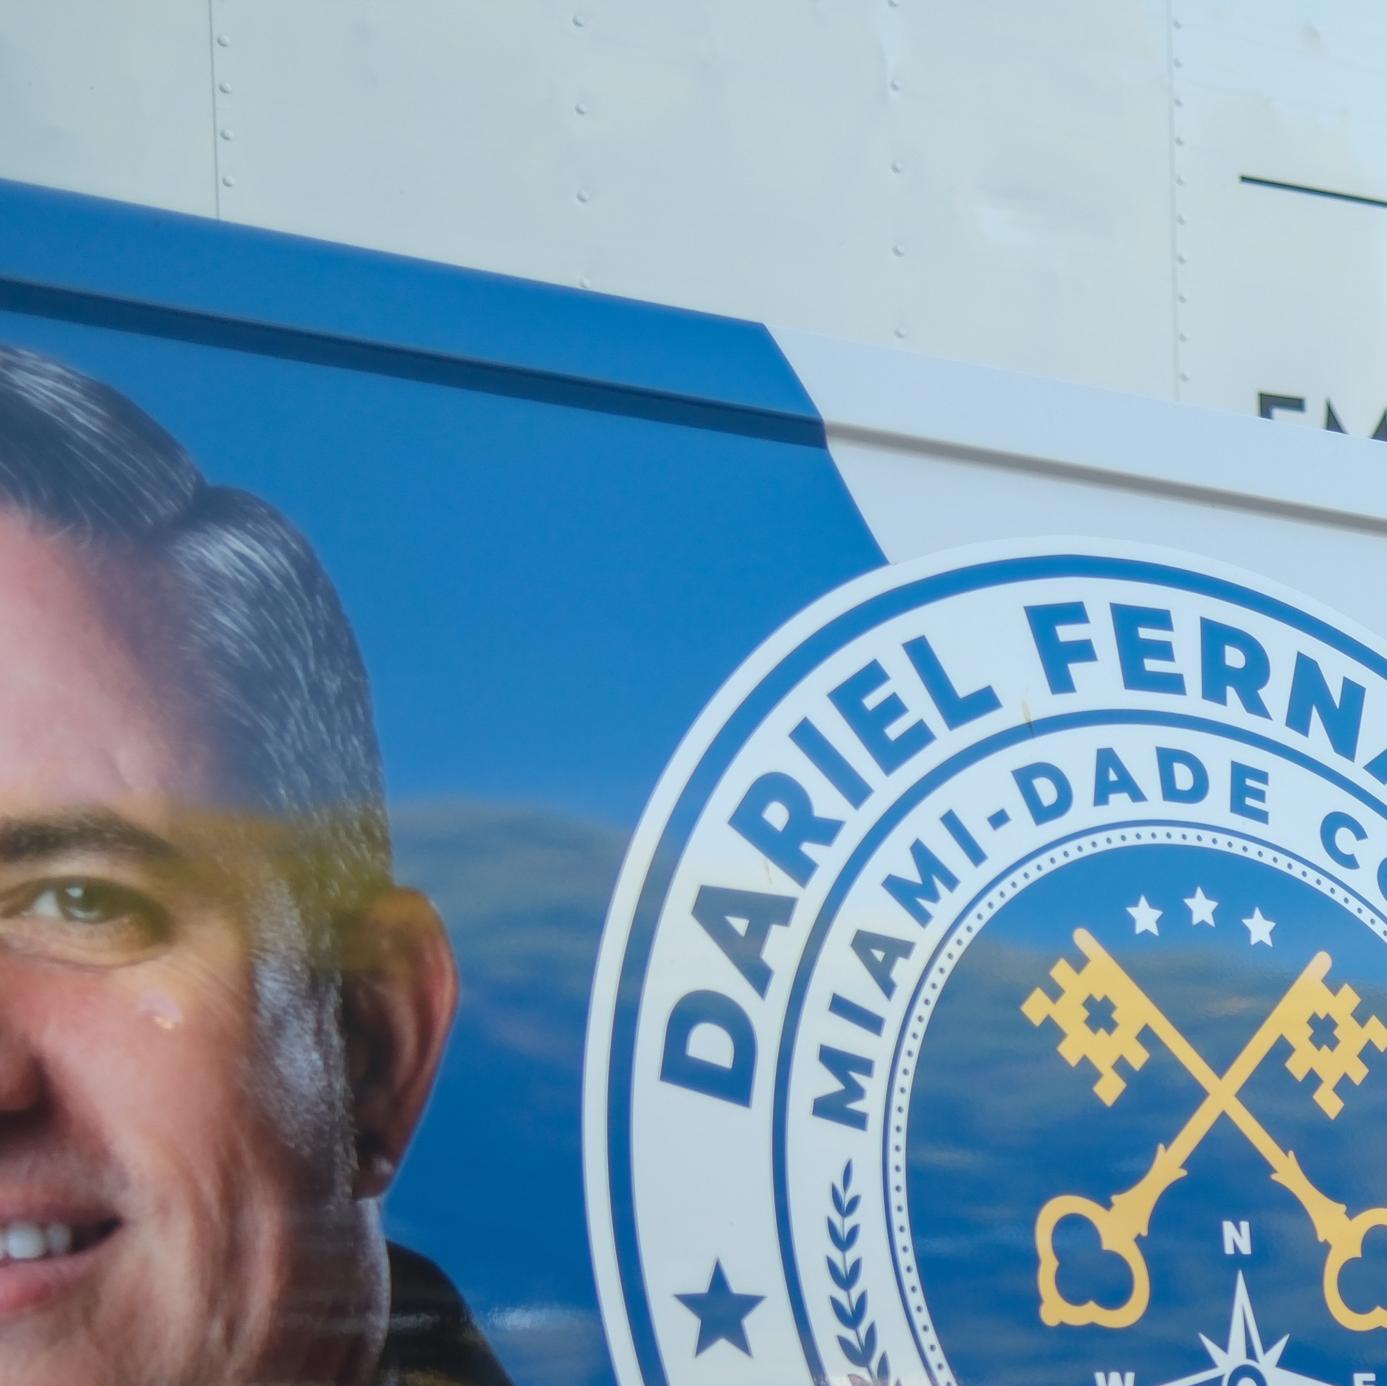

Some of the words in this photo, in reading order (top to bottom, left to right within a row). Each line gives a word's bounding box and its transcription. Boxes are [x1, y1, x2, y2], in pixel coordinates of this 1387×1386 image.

[660, 635, 1003, 1108] DARIEL
[811, 745, 1270, 1131] MIAMI-DADE
[1222, 1220, 1252, 1255] N
